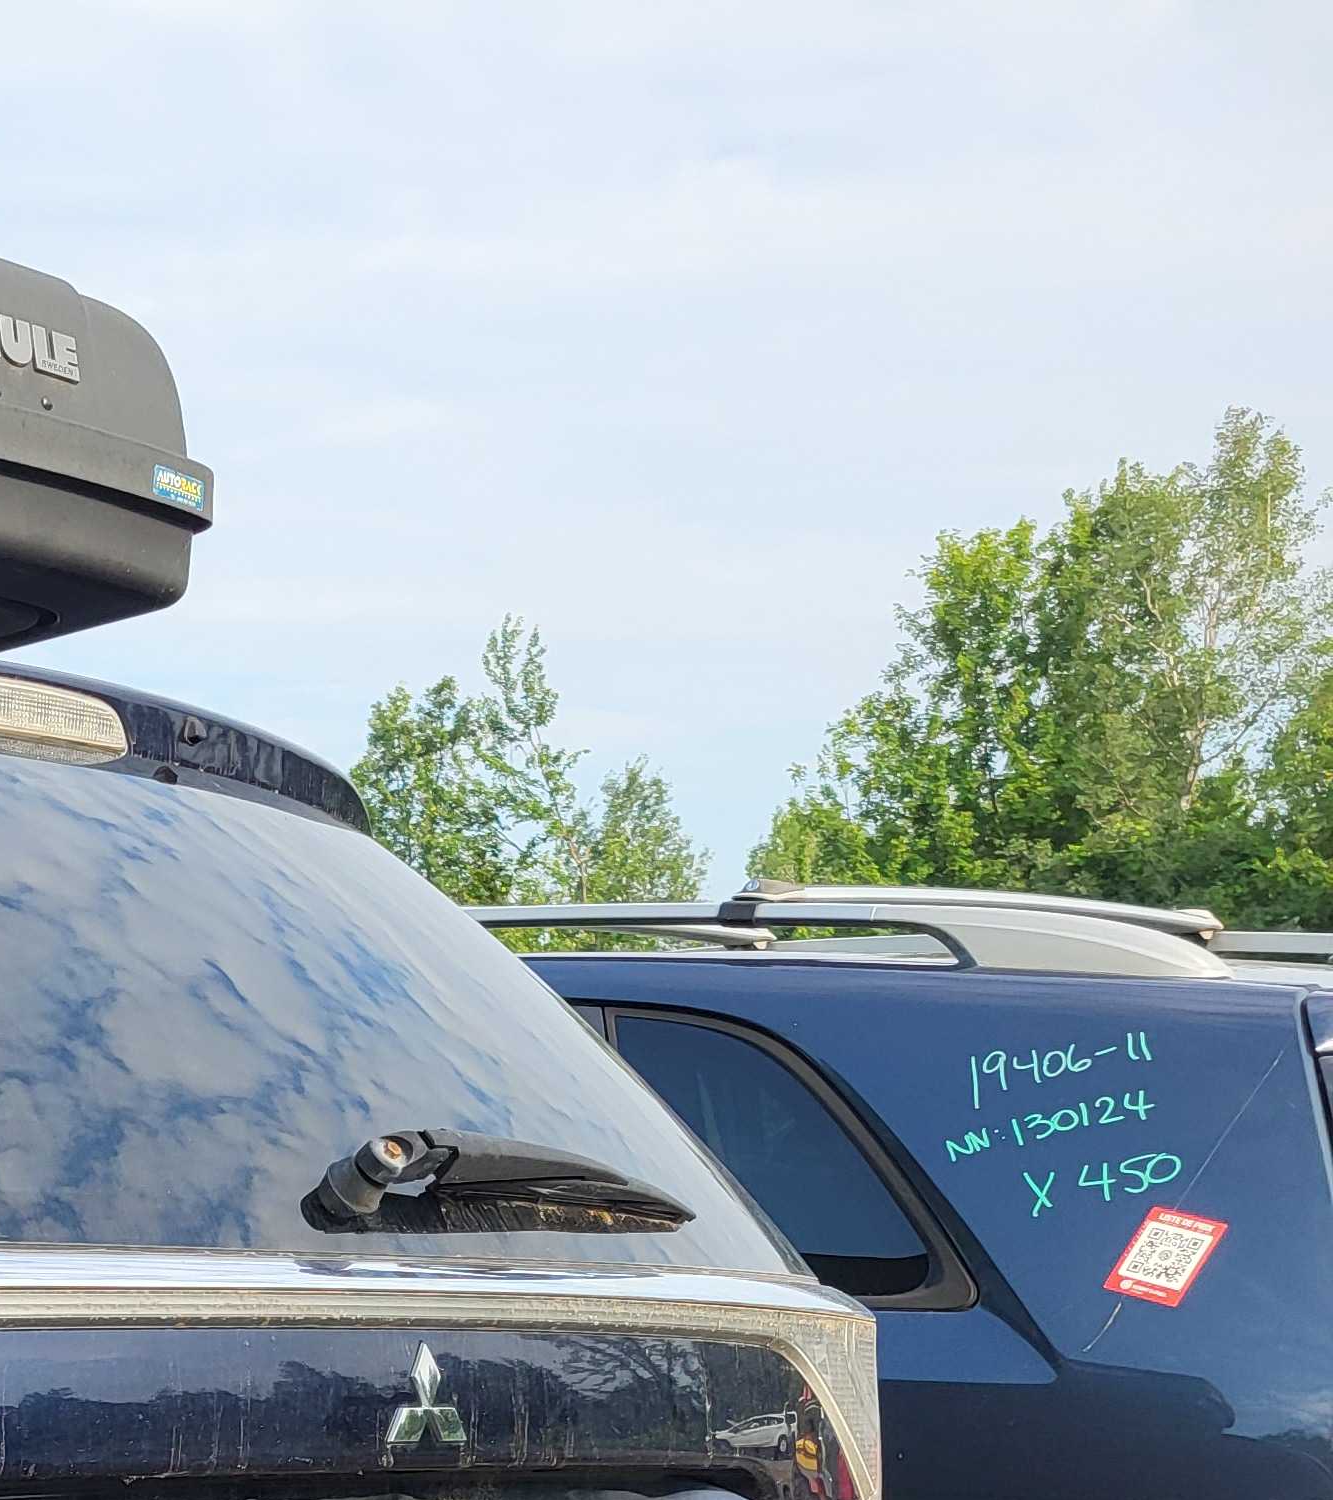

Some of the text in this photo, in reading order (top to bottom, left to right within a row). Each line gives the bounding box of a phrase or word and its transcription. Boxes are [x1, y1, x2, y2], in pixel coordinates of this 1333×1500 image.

[41, 358, 74, 377] SWEDEN
[970, 1031, 1152, 1109] 19406-11
[1077, 1152, 1181, 1202] 450
